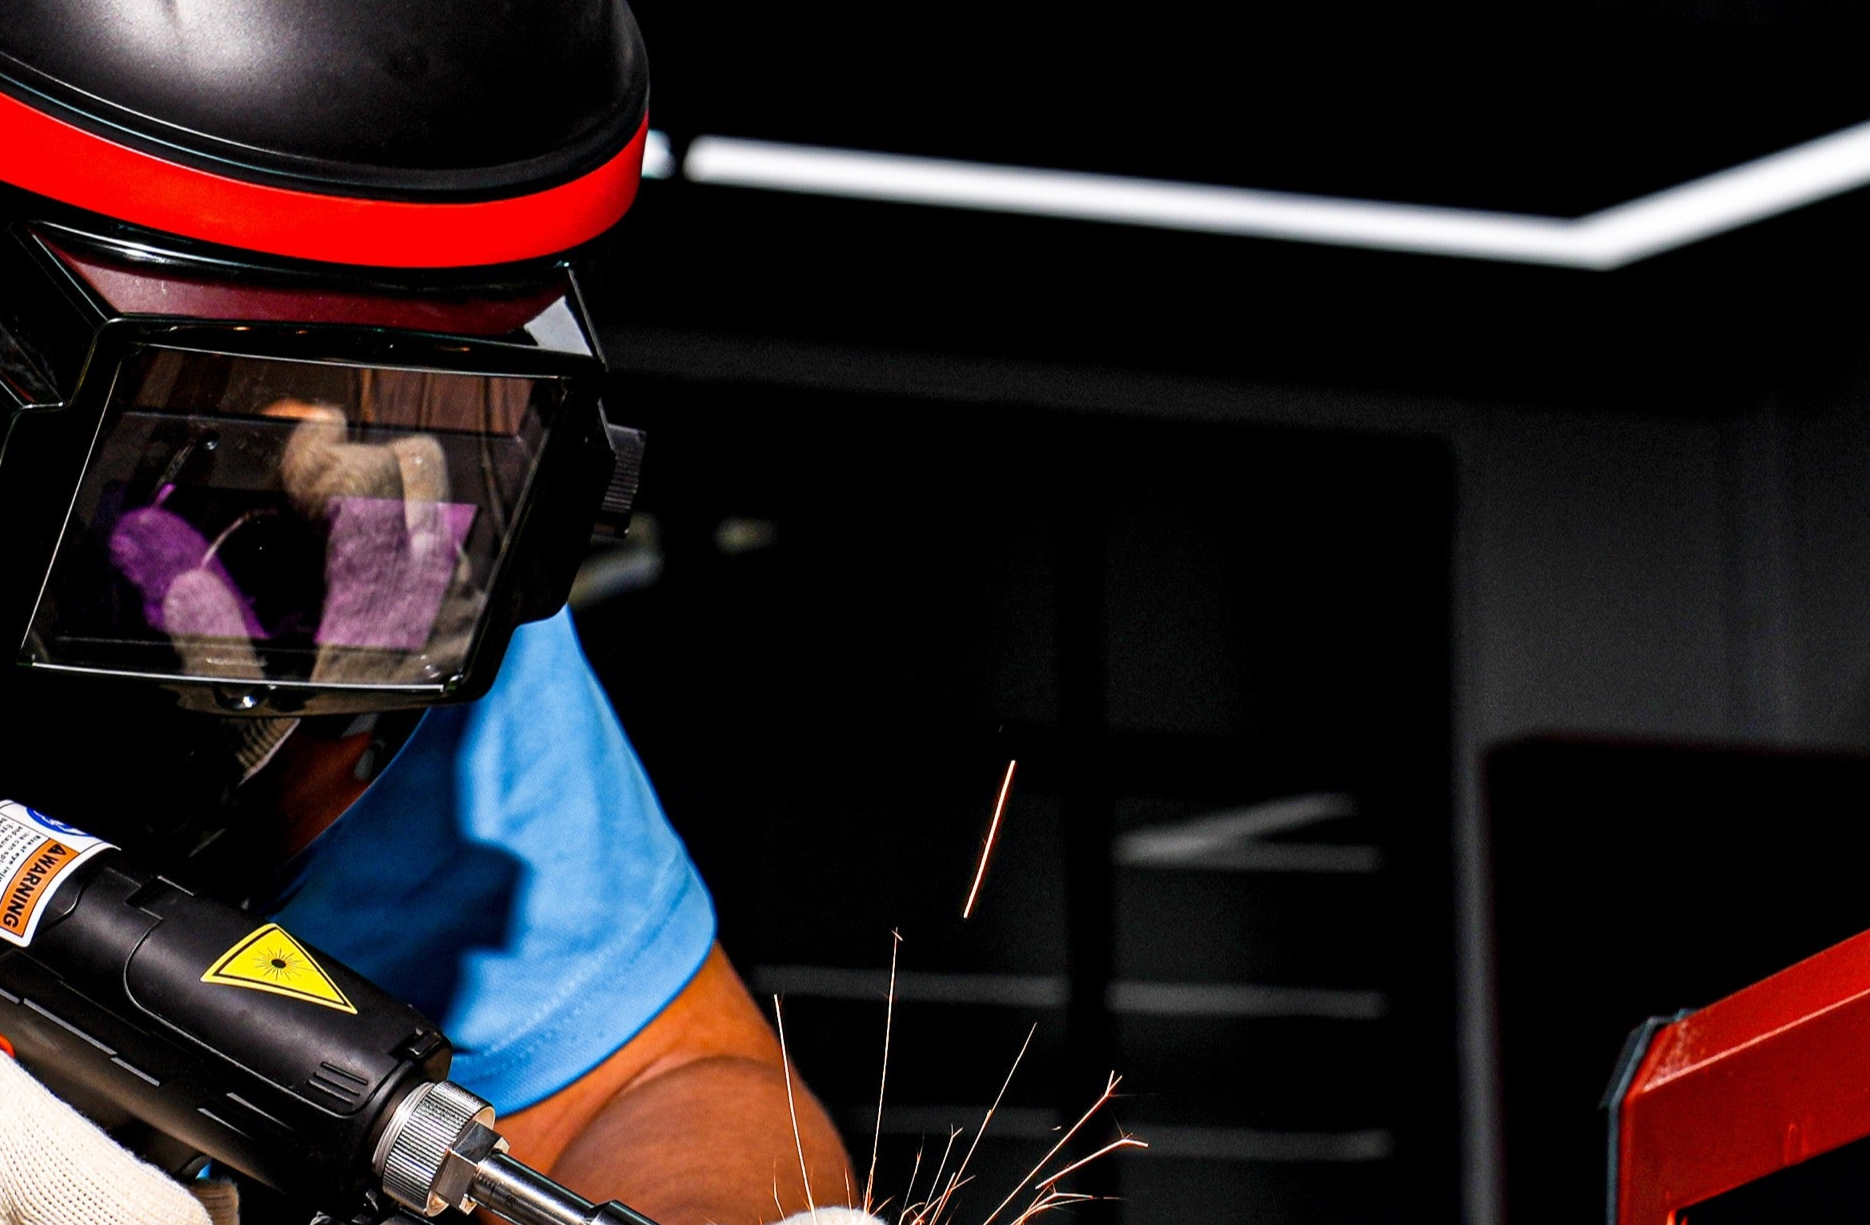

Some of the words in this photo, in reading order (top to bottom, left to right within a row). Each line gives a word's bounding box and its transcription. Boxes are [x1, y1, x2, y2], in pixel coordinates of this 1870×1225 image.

[8, 840, 19, 850] can
[8, 852, 20, 865] eye
[3, 854, 59, 928] WARNING
